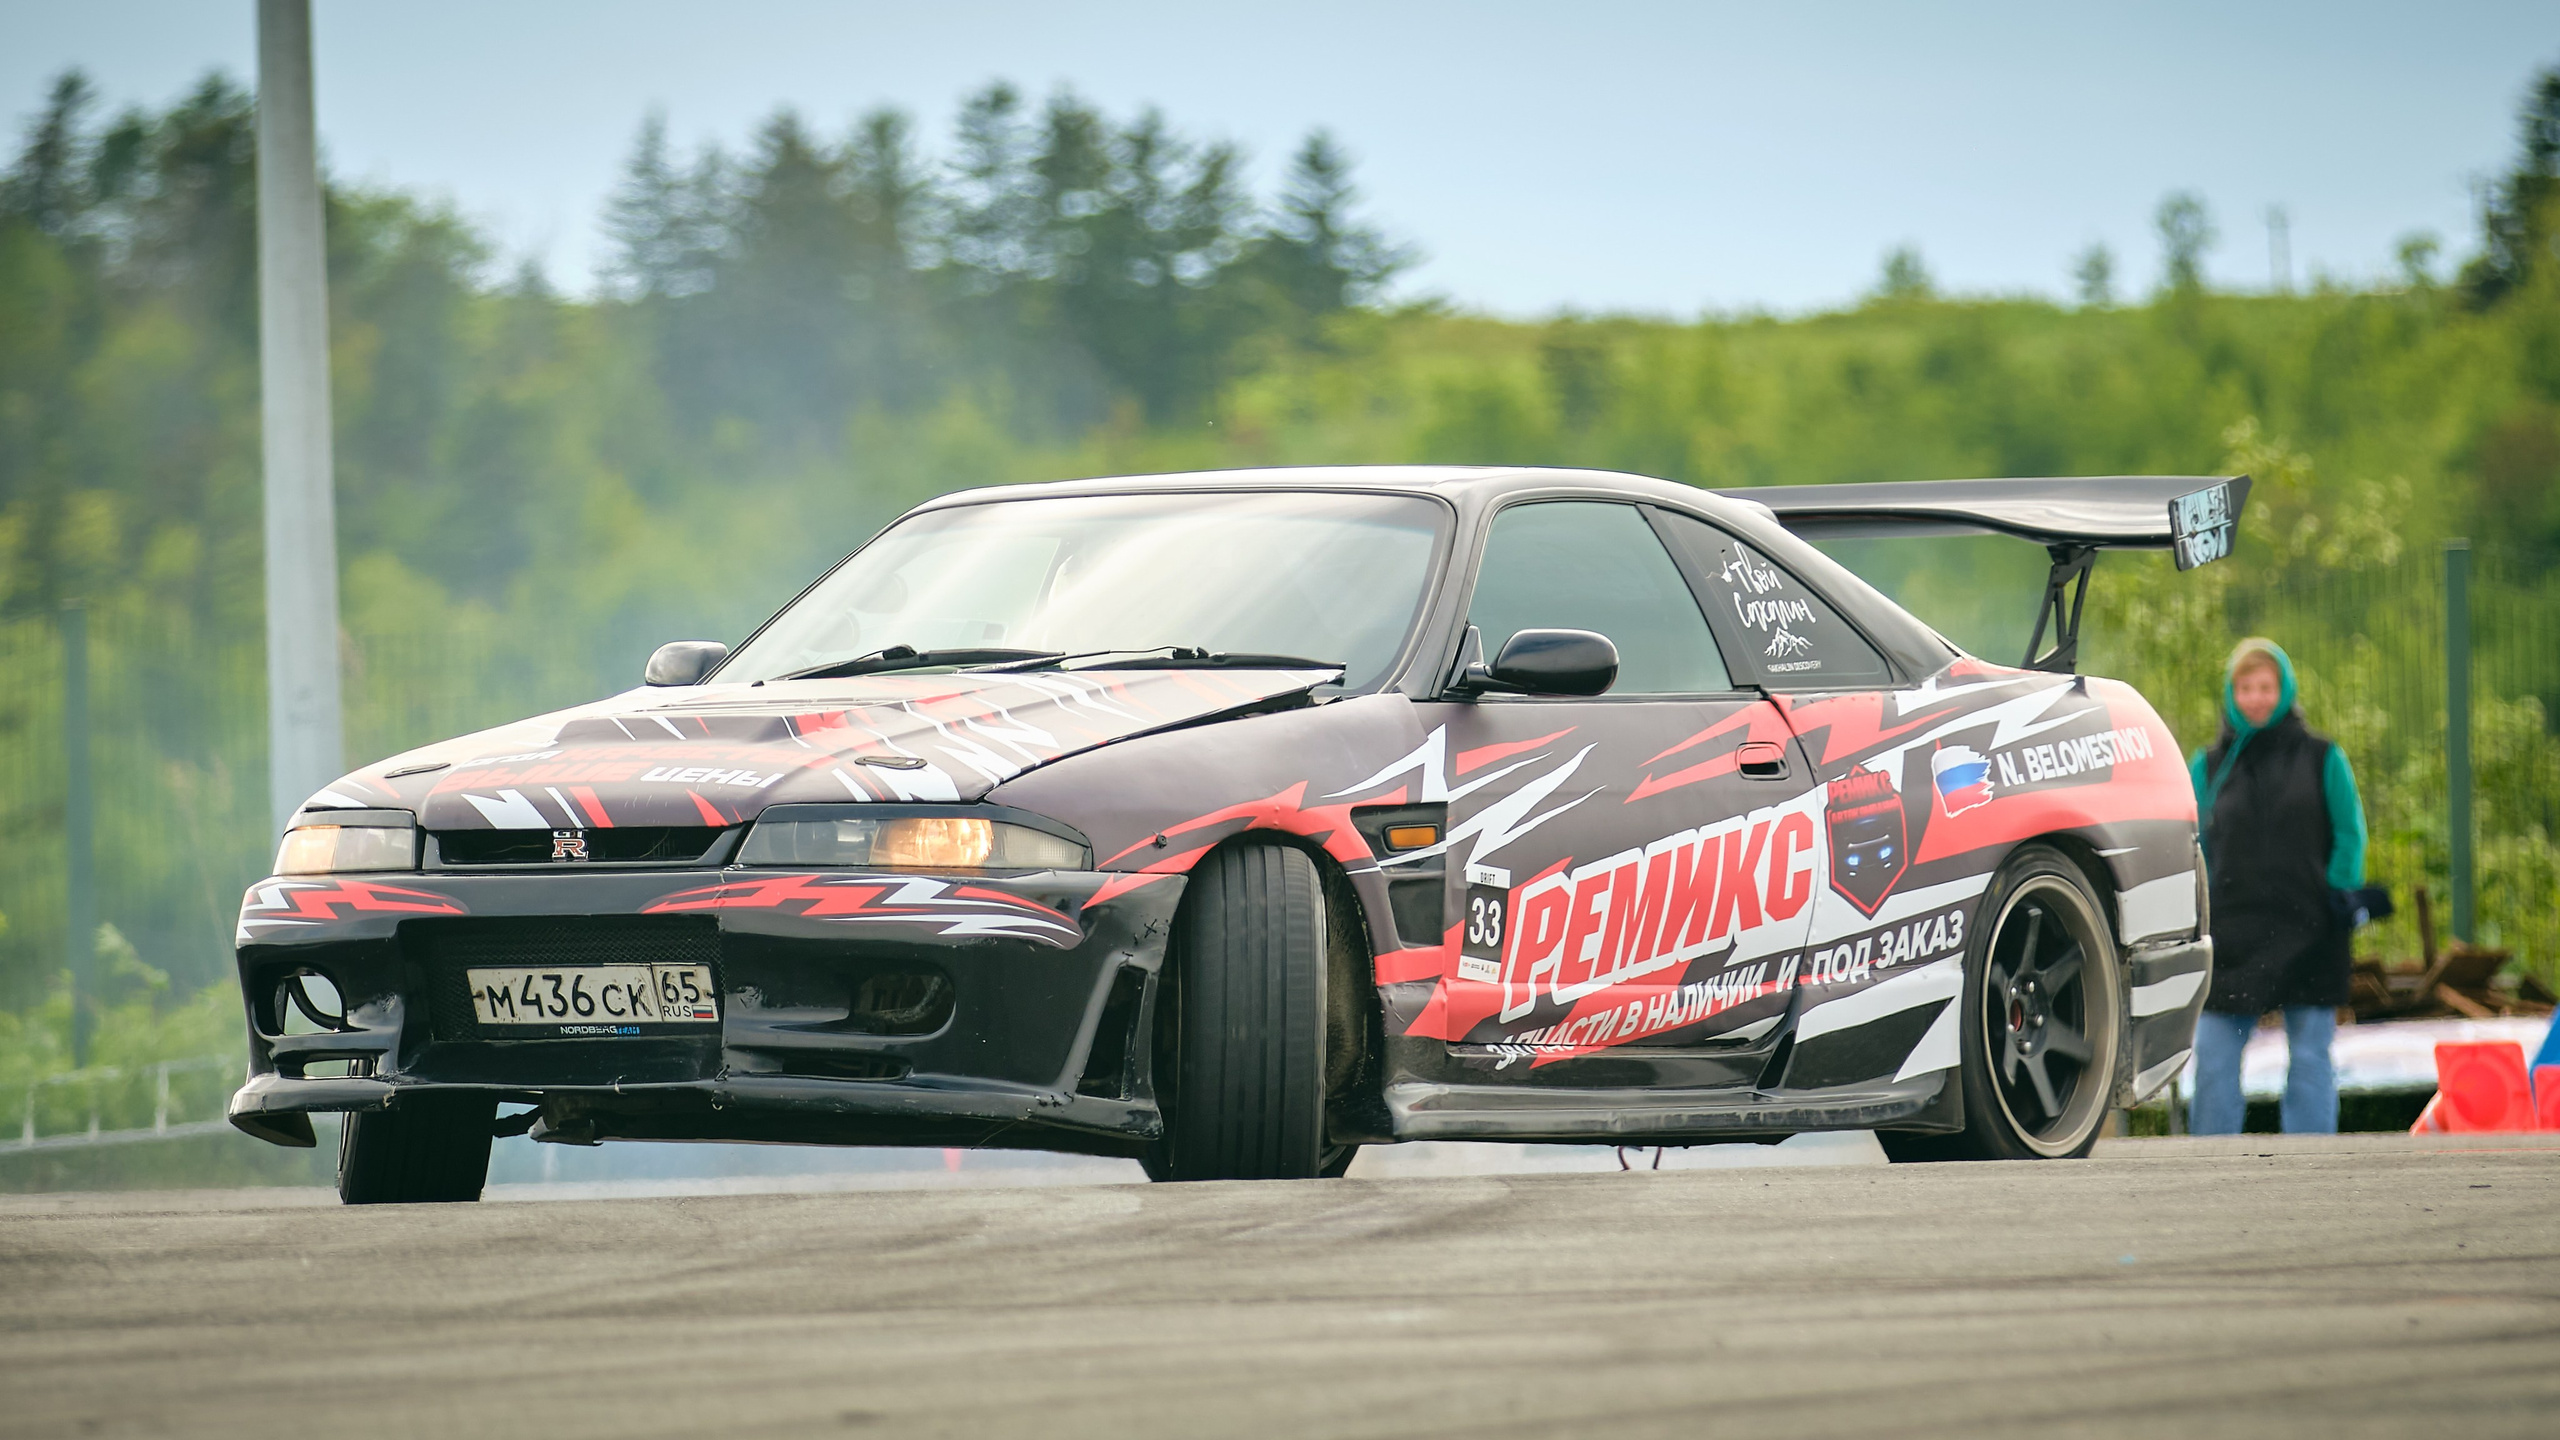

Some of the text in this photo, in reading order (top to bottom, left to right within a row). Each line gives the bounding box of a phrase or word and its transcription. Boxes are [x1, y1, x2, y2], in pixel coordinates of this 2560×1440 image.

[1729, 541, 1783, 595] Твой
[1733, 592, 1817, 632] Сахалин
[640, 766, 785, 788] ЦЕНЫ
[1997, 726, 2153, 787] N. BELOMESTNOV
[1469, 897, 1501, 947] 33
[1502, 810, 1815, 1015] РЕМИКС
[662, 971, 701, 1004] 65
[1617, 1000, 1643, 1037] В
[1641, 962, 1768, 1033] НАЛИЧИИ
[1776, 954, 1802, 994] И
[1811, 937, 1873, 985] ПОД
[1876, 909, 1965, 969] ЗАКАЗ
[663, 1005, 692, 1018] RUS
